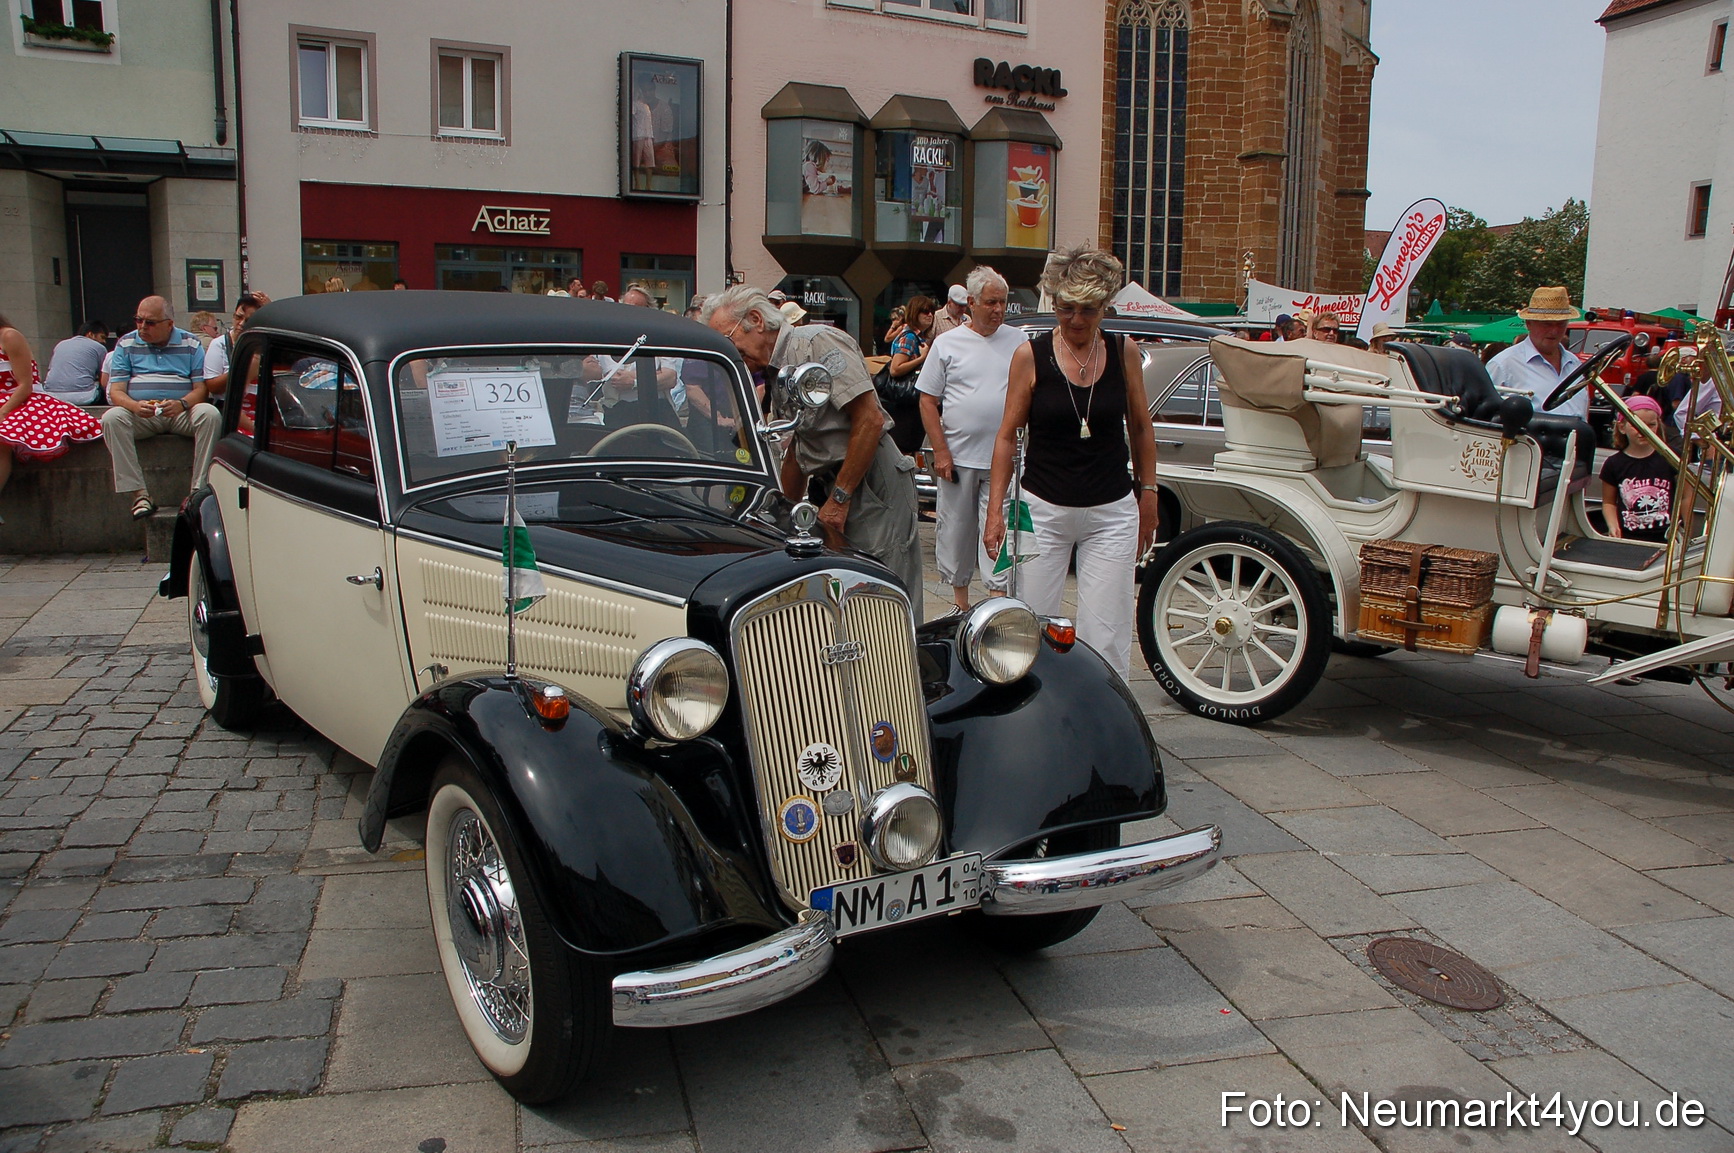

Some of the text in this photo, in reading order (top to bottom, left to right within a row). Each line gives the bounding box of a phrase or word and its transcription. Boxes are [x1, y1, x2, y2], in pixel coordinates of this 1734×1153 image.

[974, 57, 1068, 98] RACKL
[985, 92, 1056, 111] am Rathaus
[930, 137, 949, 145] Jahre
[913, 146, 944, 165] RACKL
[471, 205, 551, 234] Achatz
[1411, 218, 1441, 258] IMBISS
[1367, 212, 1424, 311] Lehmeier's
[804, 291, 826, 303] RACKL
[1292, 295, 1361, 316] Lhmeier's
[1336, 313, 1361, 323] MBISS
[485, 382, 531, 404] 326
[1471, 458, 1494, 467] JAHRE
[1476, 448, 1490, 458] 102
[1153, 662, 1181, 696] CORD
[1199, 703, 1261, 719] DUNLOP
[963, 861, 977, 874] 04
[963, 887, 977, 900] 10
[835, 882, 885, 931] NM
